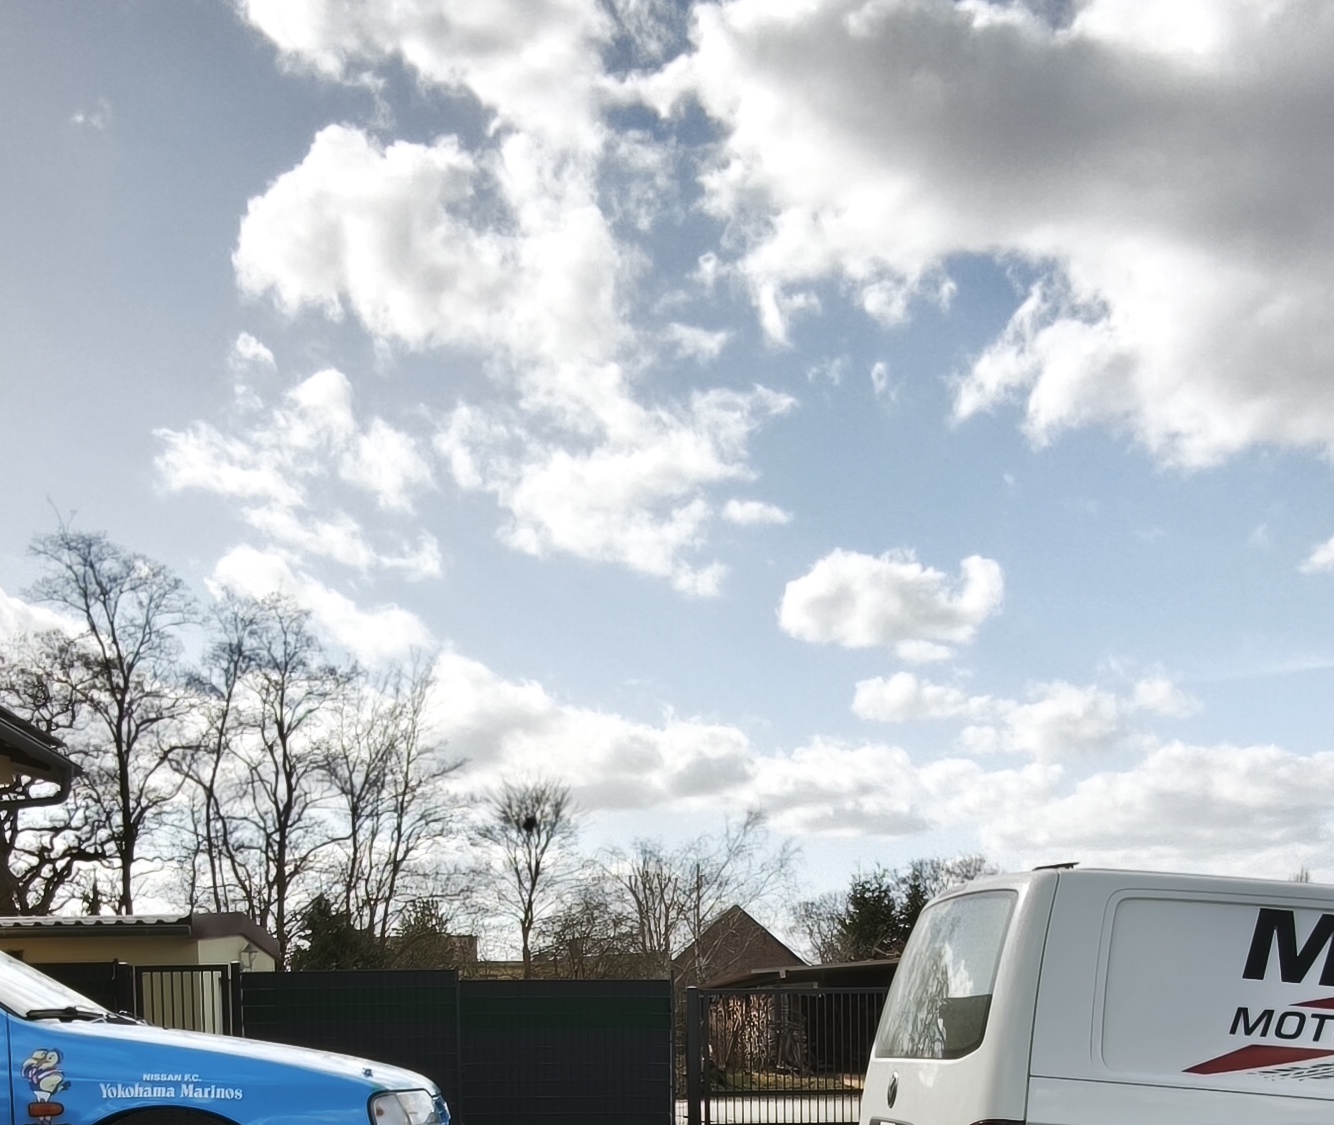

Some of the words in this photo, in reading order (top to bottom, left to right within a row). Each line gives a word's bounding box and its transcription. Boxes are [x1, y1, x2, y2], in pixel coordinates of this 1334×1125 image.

[142, 1073, 182, 1082] NISSAN
[184, 1074, 202, 1082] F.C.
[99, 1083, 175, 1099] Yokohama
[179, 1084, 243, 1100] Marinos
